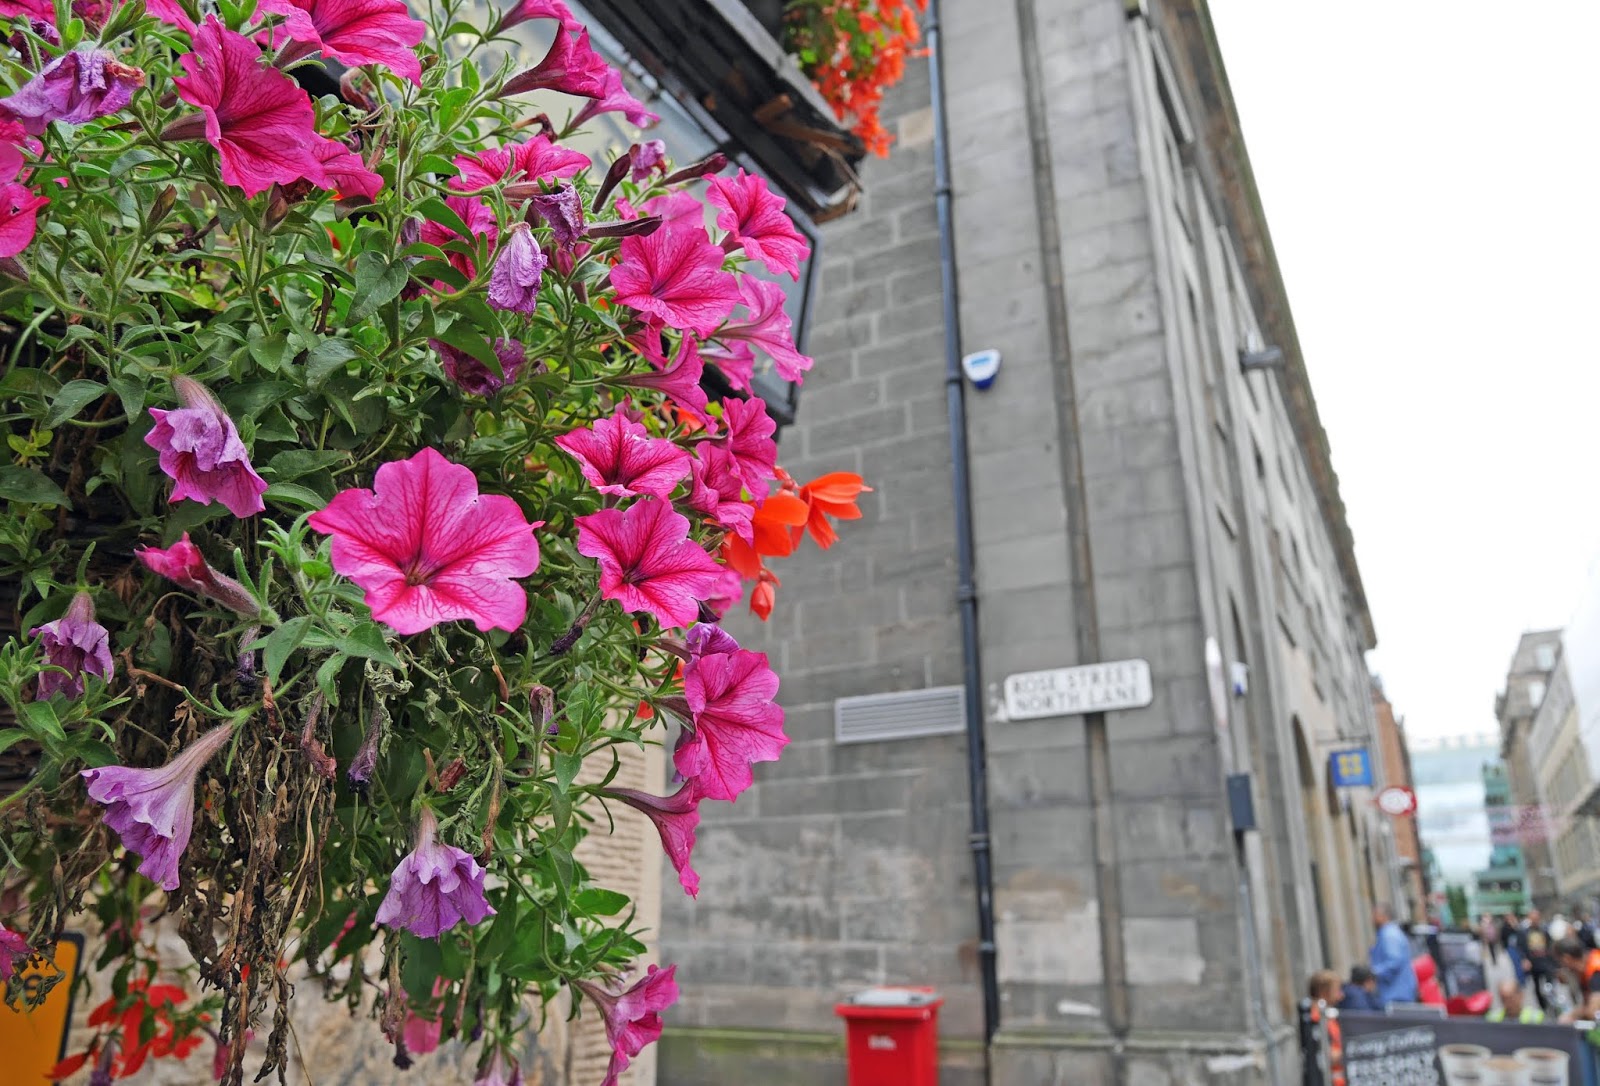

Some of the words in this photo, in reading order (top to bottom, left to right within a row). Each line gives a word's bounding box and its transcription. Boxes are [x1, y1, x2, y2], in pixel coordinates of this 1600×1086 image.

[1013, 674, 1056, 695] ROSE
[1067, 664, 1139, 689] STREET
[1015, 692, 1081, 712] NORTH
[1087, 685, 1138, 706] LANE
